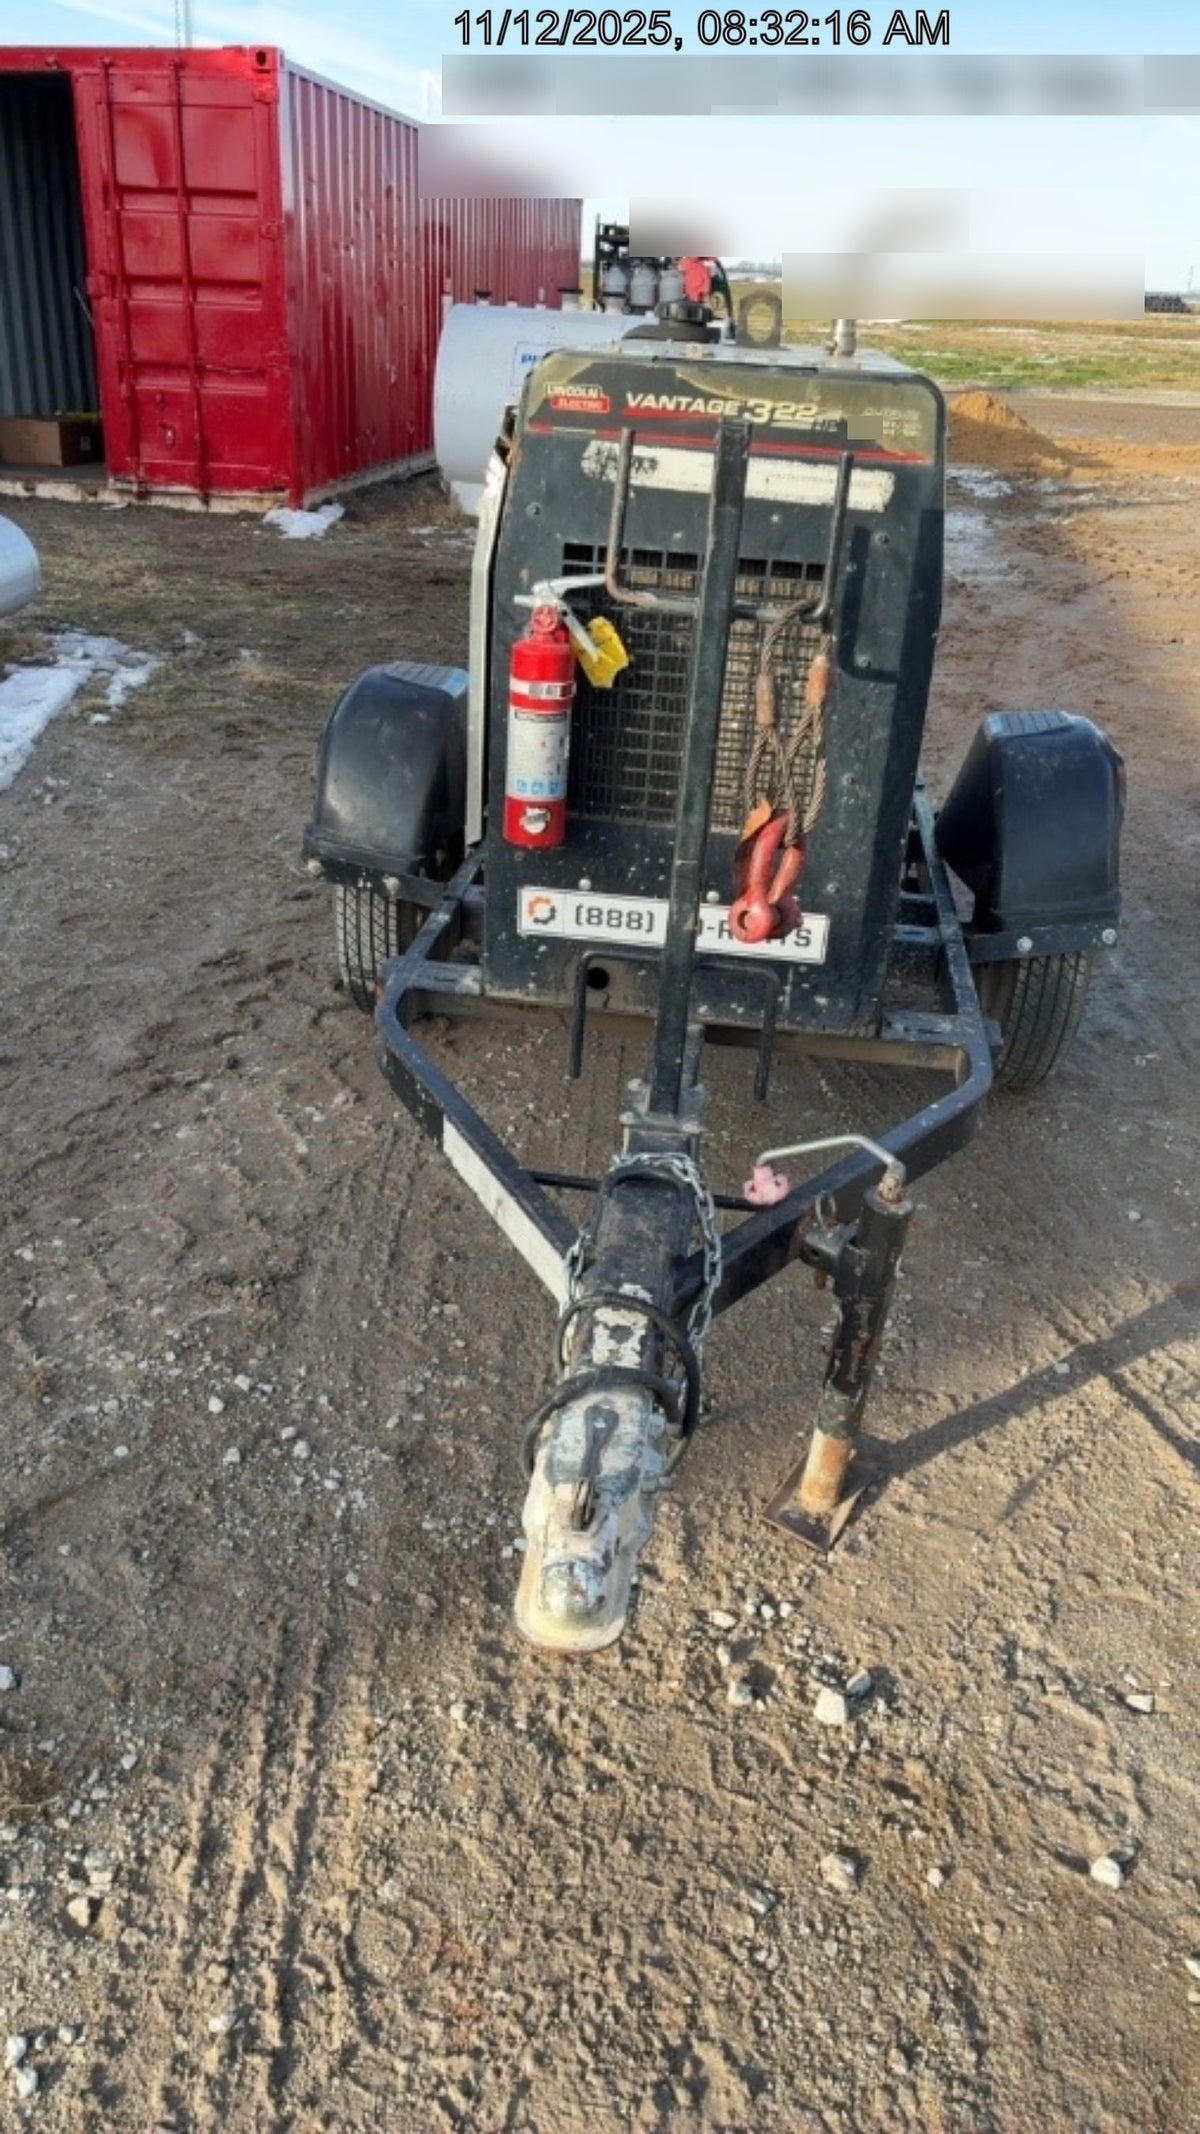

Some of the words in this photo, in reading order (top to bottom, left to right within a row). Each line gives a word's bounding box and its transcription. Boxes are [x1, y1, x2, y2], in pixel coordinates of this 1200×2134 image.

[625, 391, 739, 416] VANTAGE
[743, 398, 818, 424] 322
[575, 905, 656, 933] (888)
